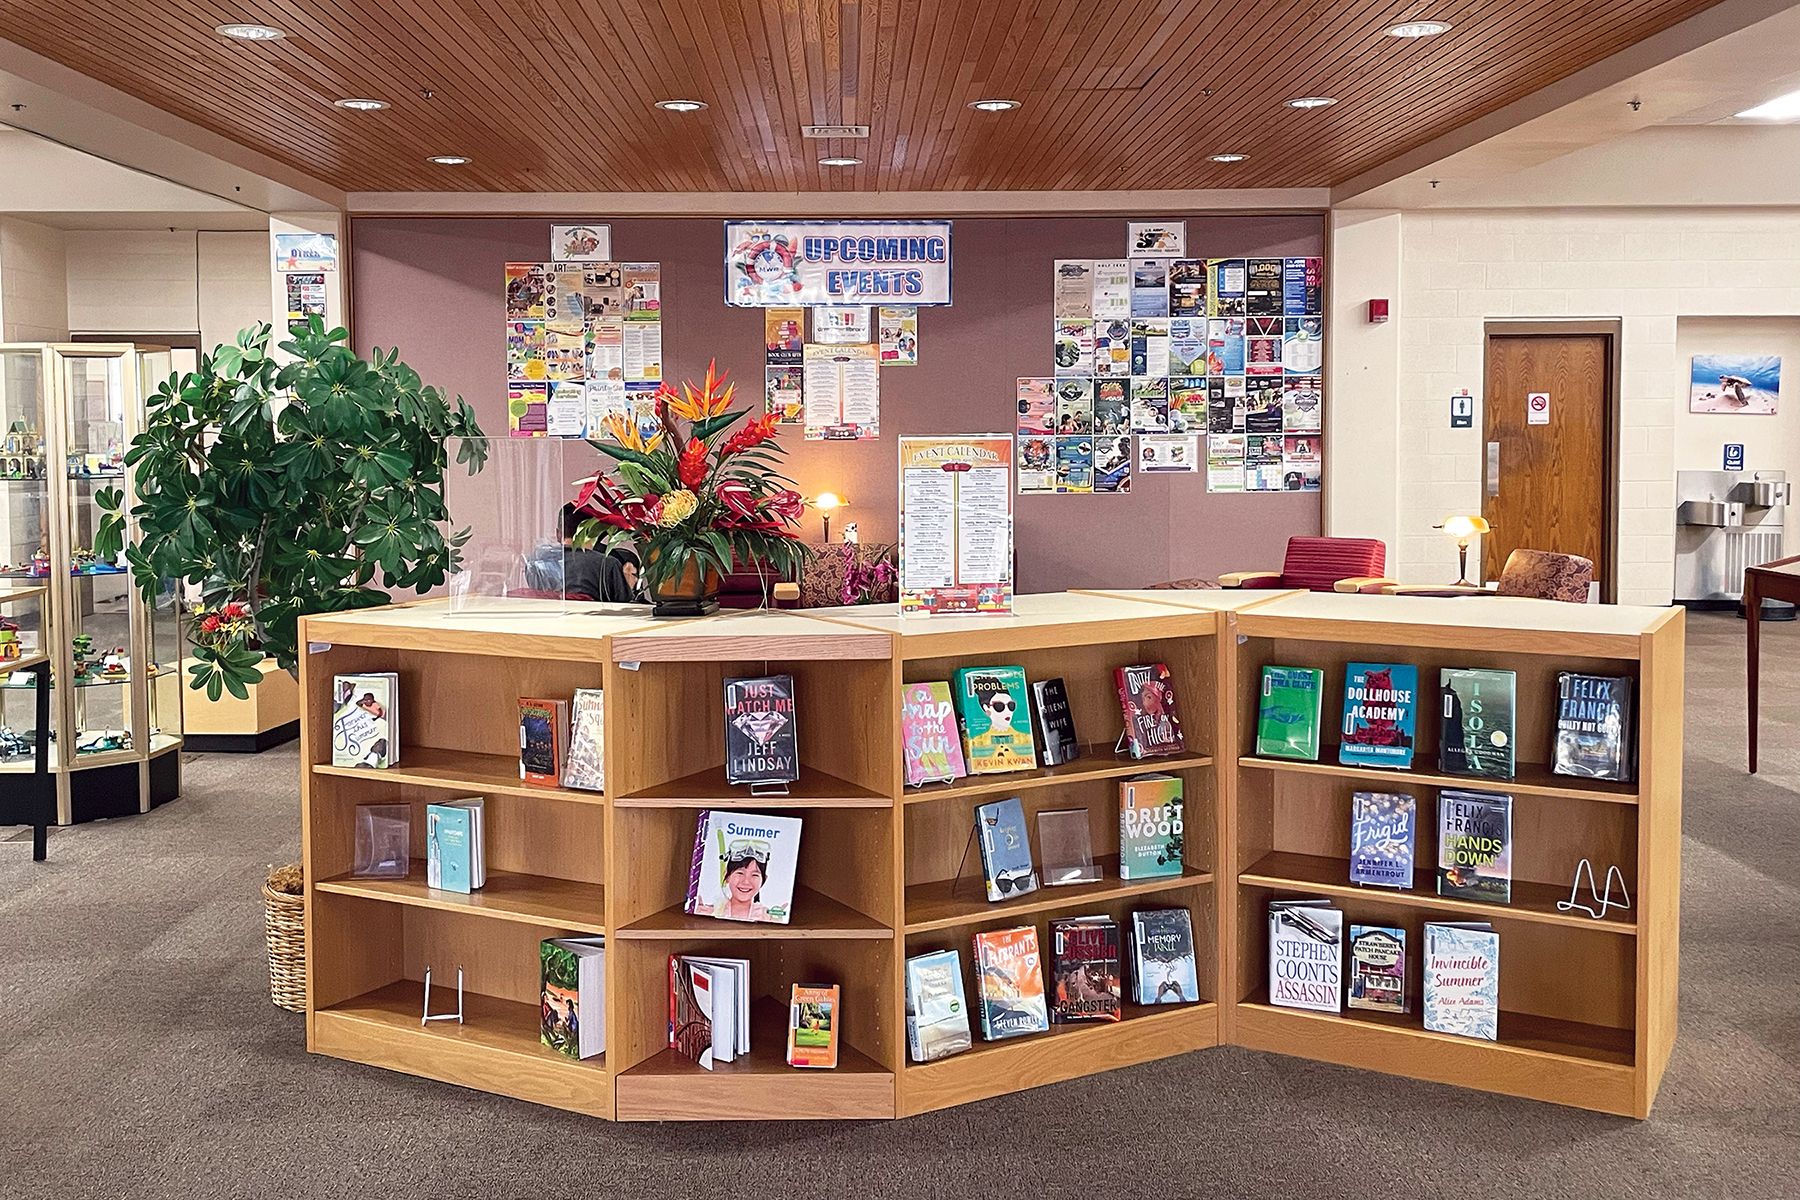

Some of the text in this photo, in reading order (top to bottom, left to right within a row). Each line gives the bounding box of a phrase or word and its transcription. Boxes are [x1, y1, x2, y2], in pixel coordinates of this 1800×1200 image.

[803, 236, 946, 262] UPCOMING
[553, 264, 567, 272] ART
[826, 270, 924, 296] EVENTS
[1306, 267, 1316, 310] FITNESS
[508, 335, 525, 344] MOM
[914, 446, 999, 461] EVENT CALENDAR
[972, 682, 1020, 691] PROBLEMS
[1154, 681, 1167, 692] THE
[1354, 675, 1365, 683] THE
[743, 684, 775, 698] JUST
[916, 690, 931, 702] a
[1044, 686, 1059, 696] THE
[1347, 687, 1412, 704] DOLLHOUSE
[1573, 679, 1612, 700] FELIX
[775, 698, 793, 712] ME
[902, 701, 952, 723] map
[1043, 701, 1067, 714] SILENT
[1561, 699, 1621, 722] FRANCIS
[1351, 705, 1406, 721] ACADEMY
[924, 720, 947, 734] the
[1049, 718, 1068, 729] WIFE
[1137, 713, 1157, 734] FIRE
[1468, 682, 1485, 770] ISOLA
[1558, 719, 1582, 730] GUILTY
[1582, 720, 1597, 732] NOT
[1146, 724, 1174, 746] HIGH
[748, 740, 777, 756] JEFF
[734, 756, 792, 774] LINDSAY
[975, 758, 1034, 767] KEVIN KWAN
[1125, 804, 1184, 825] DRIFT
[727, 823, 780, 839] Summer
[1126, 820, 1184, 838] WOOD
[1352, 812, 1409, 855] Frigid
[1447, 819, 1503, 836] FRANCIS
[1134, 844, 1165, 852] ELIZABETH
[1444, 834, 1502, 854] HANDS
[1358, 859, 1393, 867] JENNIFER
[1444, 848, 1496, 867] DOWN
[1355, 868, 1405, 878] ARMENTROUT
[1070, 929, 1105, 945] CLIVE
[1147, 934, 1182, 944] MEMORY
[1154, 942, 1176, 951] WALL
[1276, 940, 1338, 961] STEPHEN
[1358, 941, 1398, 949] STRAWBERRY
[1431, 955, 1488, 969] Invincible
[1276, 959, 1338, 984] COONTS
[1434, 973, 1485, 988] Summer
[1275, 980, 1337, 1005] ASSASSIN
[1060, 999, 1117, 1013] GANGSTER
[1438, 997, 1485, 1005] Alice Adams
